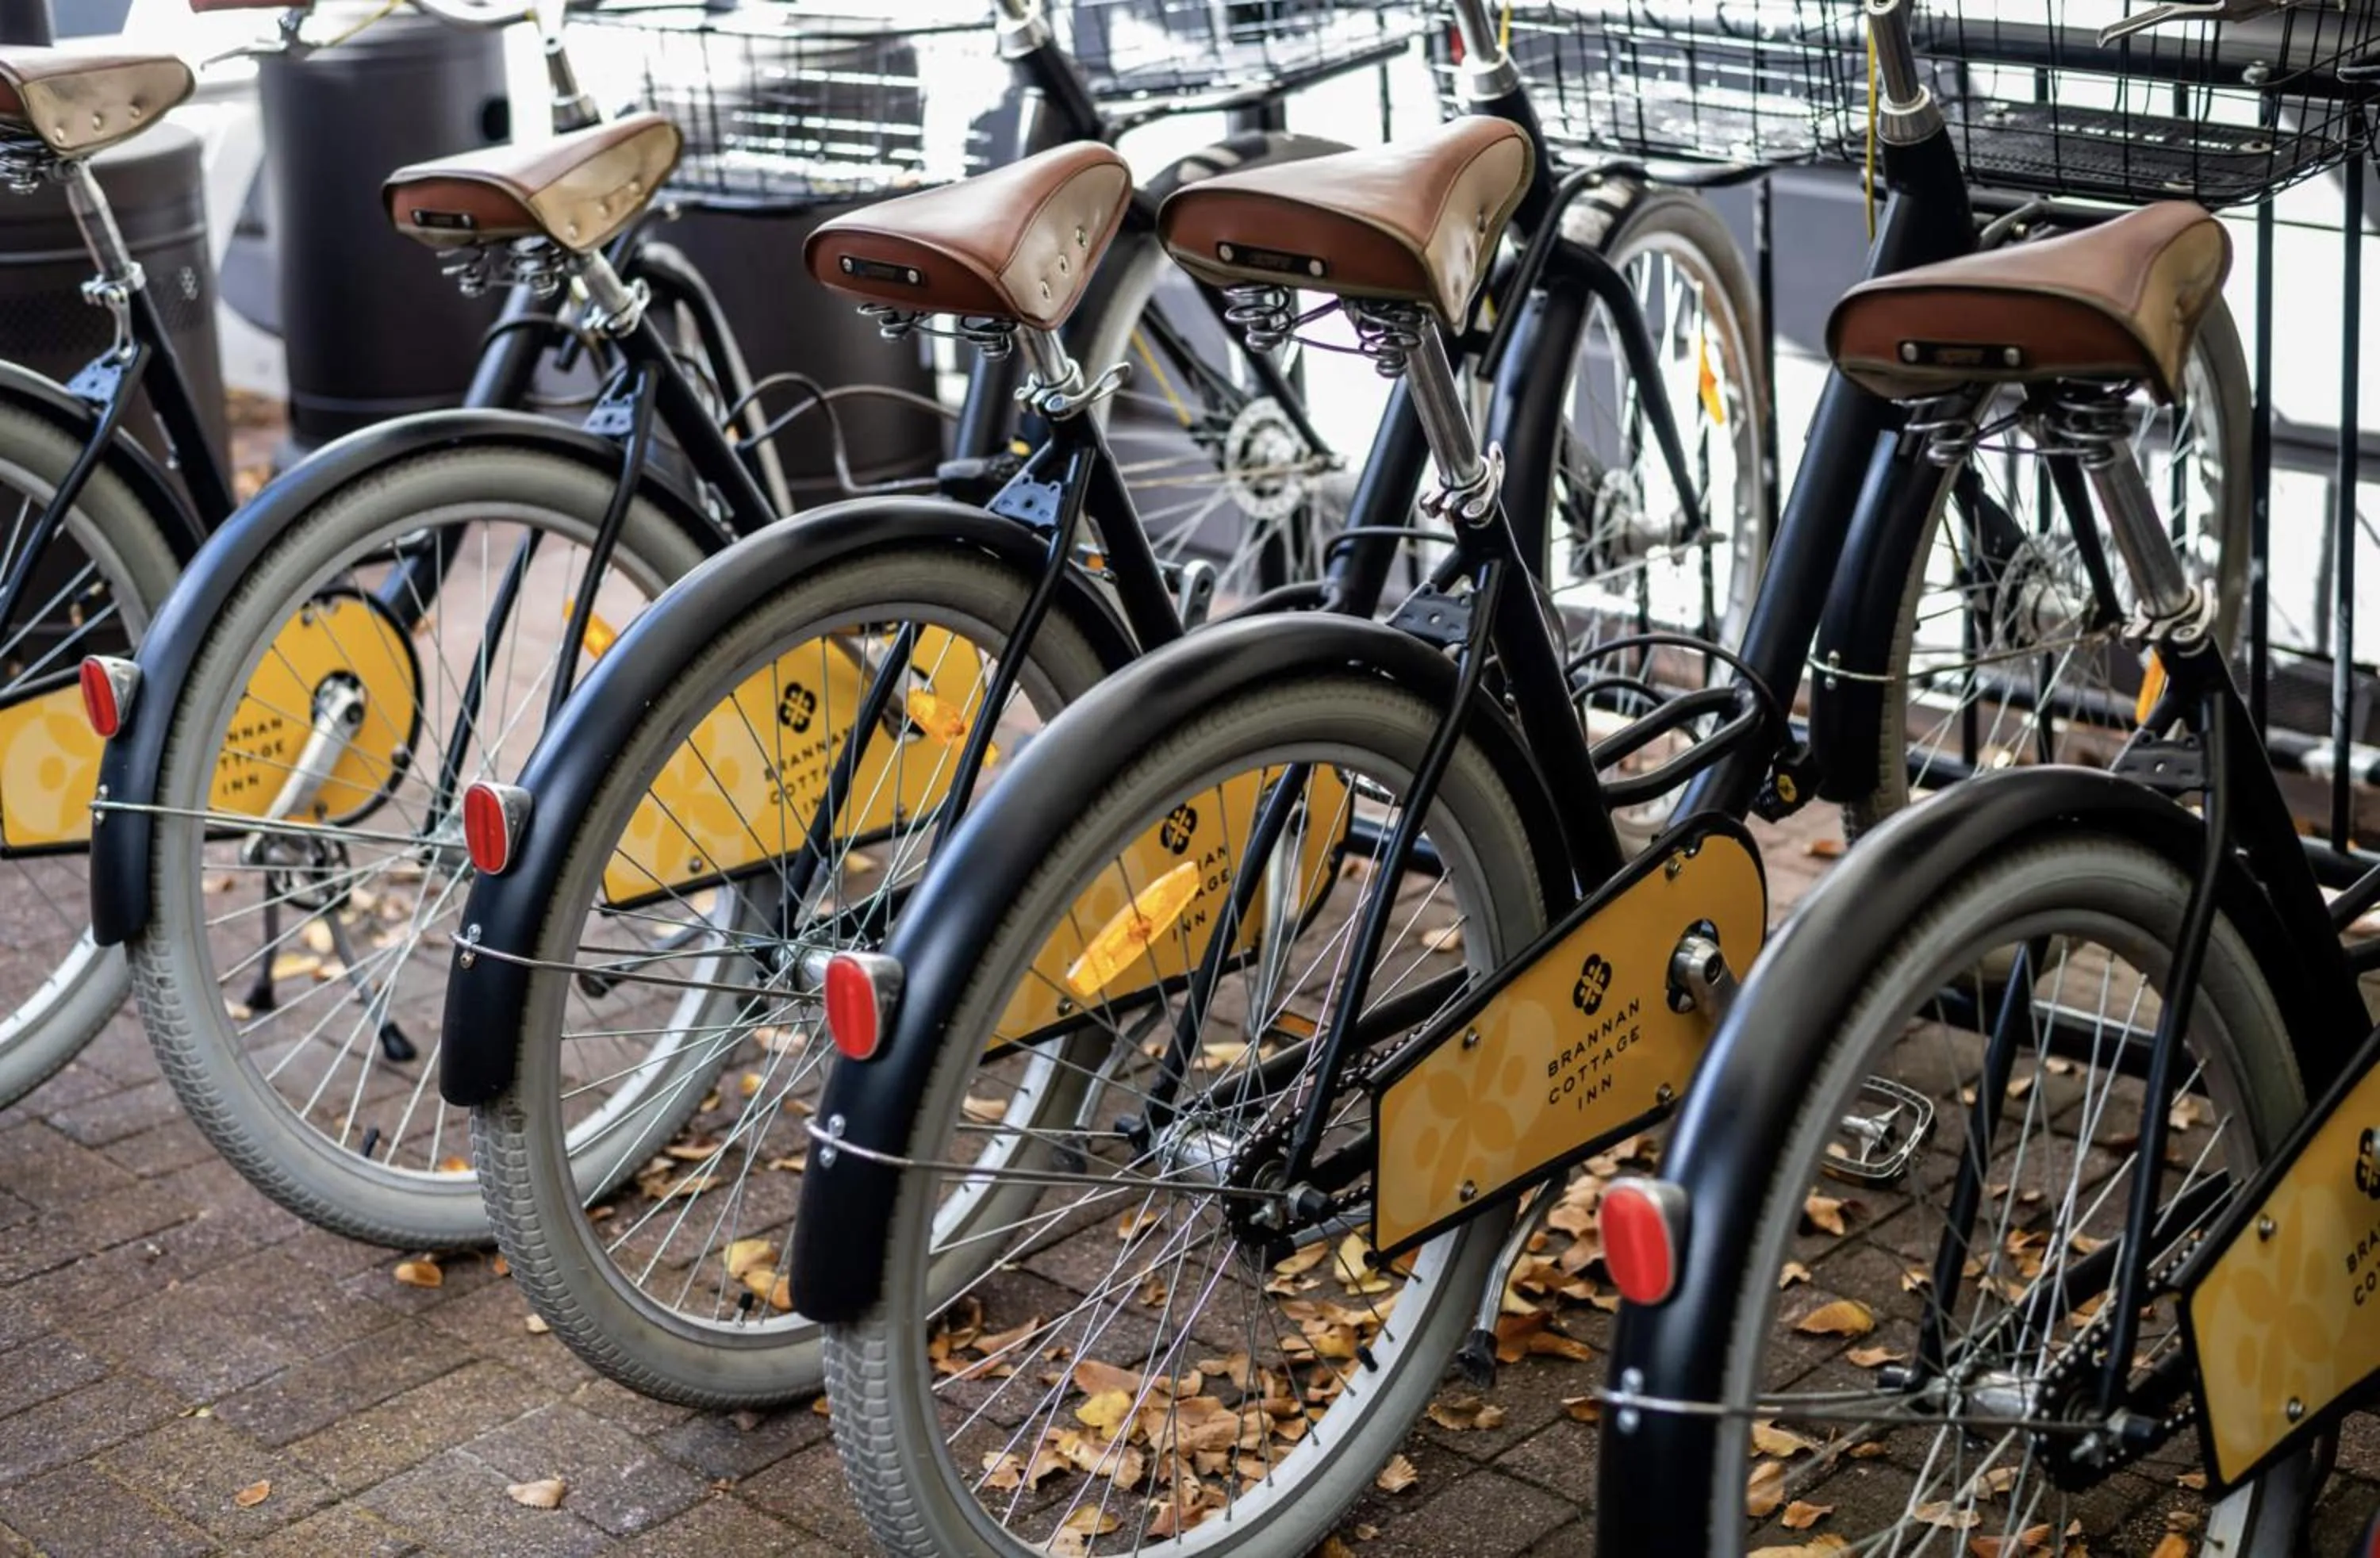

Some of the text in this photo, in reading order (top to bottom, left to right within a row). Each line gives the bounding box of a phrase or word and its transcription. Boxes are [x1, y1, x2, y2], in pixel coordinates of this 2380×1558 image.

[228, 718, 282, 743] NNAN
[221, 739, 283, 770] TTAGE
[221, 773, 259, 796] INN
[802, 793, 823, 815] IN
[1172, 909, 1207, 943] INN
[1548, 997, 1640, 1078] BRANNAN
[1549, 1025, 1641, 1105] COTTAGE
[1577, 1074, 1612, 1111] INN
